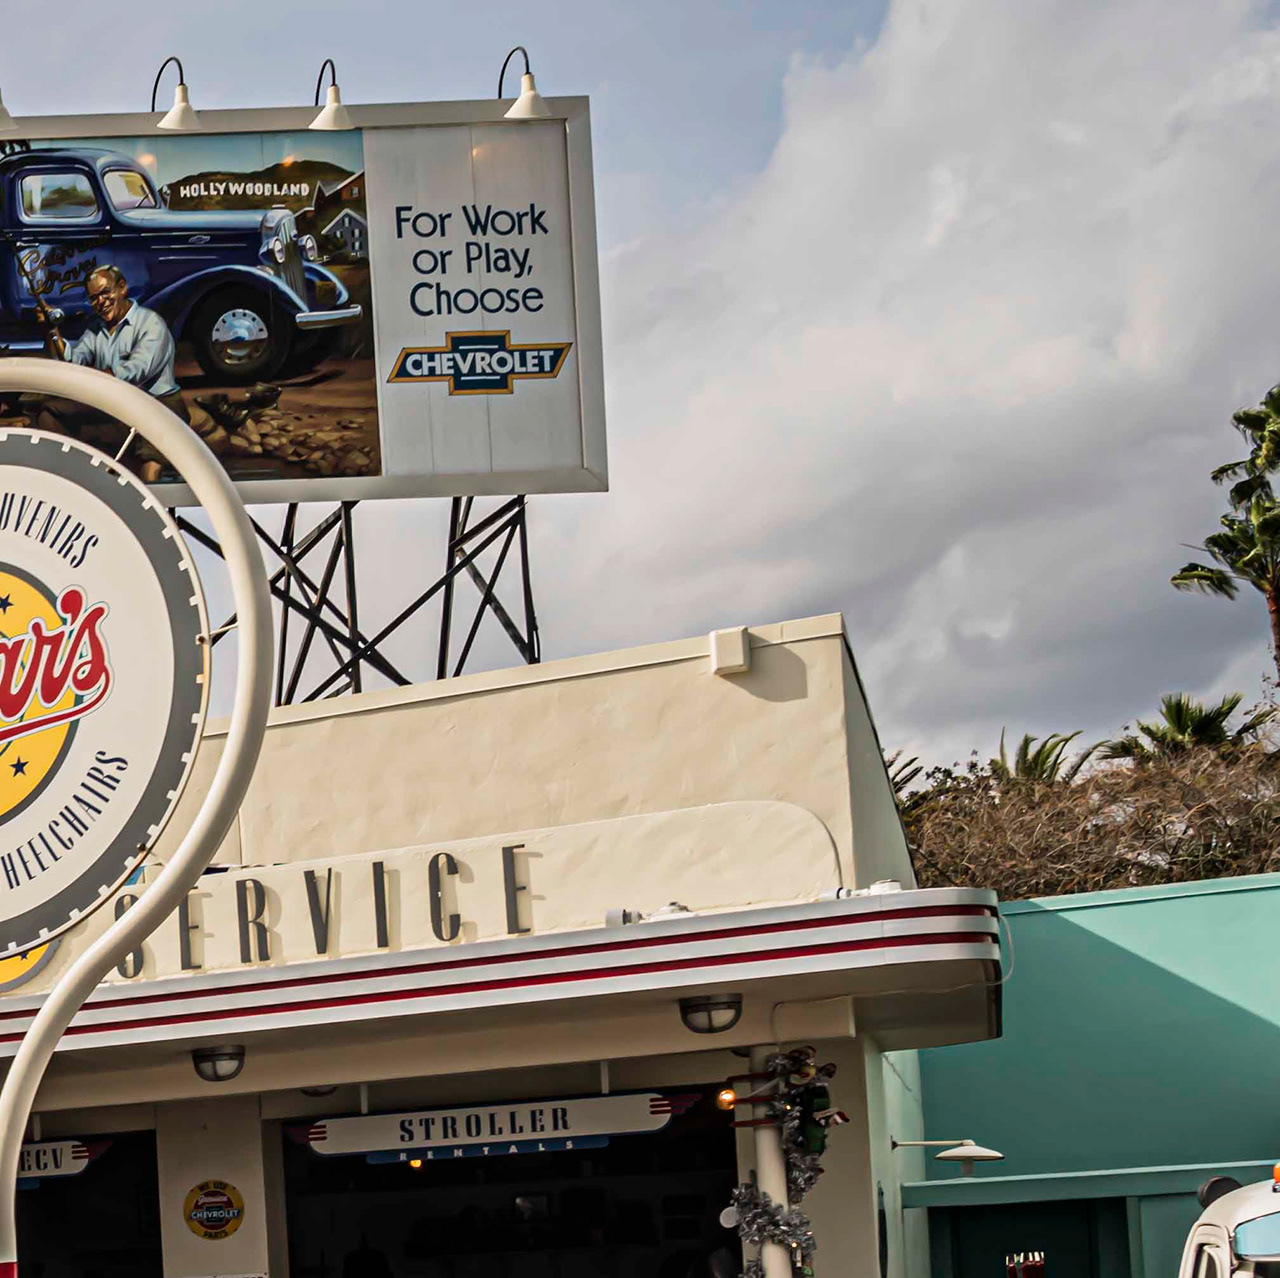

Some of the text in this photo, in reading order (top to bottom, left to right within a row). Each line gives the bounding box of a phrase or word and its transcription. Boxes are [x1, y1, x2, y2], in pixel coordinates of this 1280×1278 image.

[180, 182, 310, 198] HOLLYWOODLAND
[395, 203, 549, 239] For Work
[412, 241, 533, 279] or Play,
[409, 281, 544, 317] Choose
[405, 350, 554, 377] CHEVROLET
[114, 843, 532, 979] SERVICE
[400, 1107, 571, 1142] STROLLER
[399, 1140, 574, 1161] RENTALS
[191, 1209, 240, 1219] CHEVROLET
